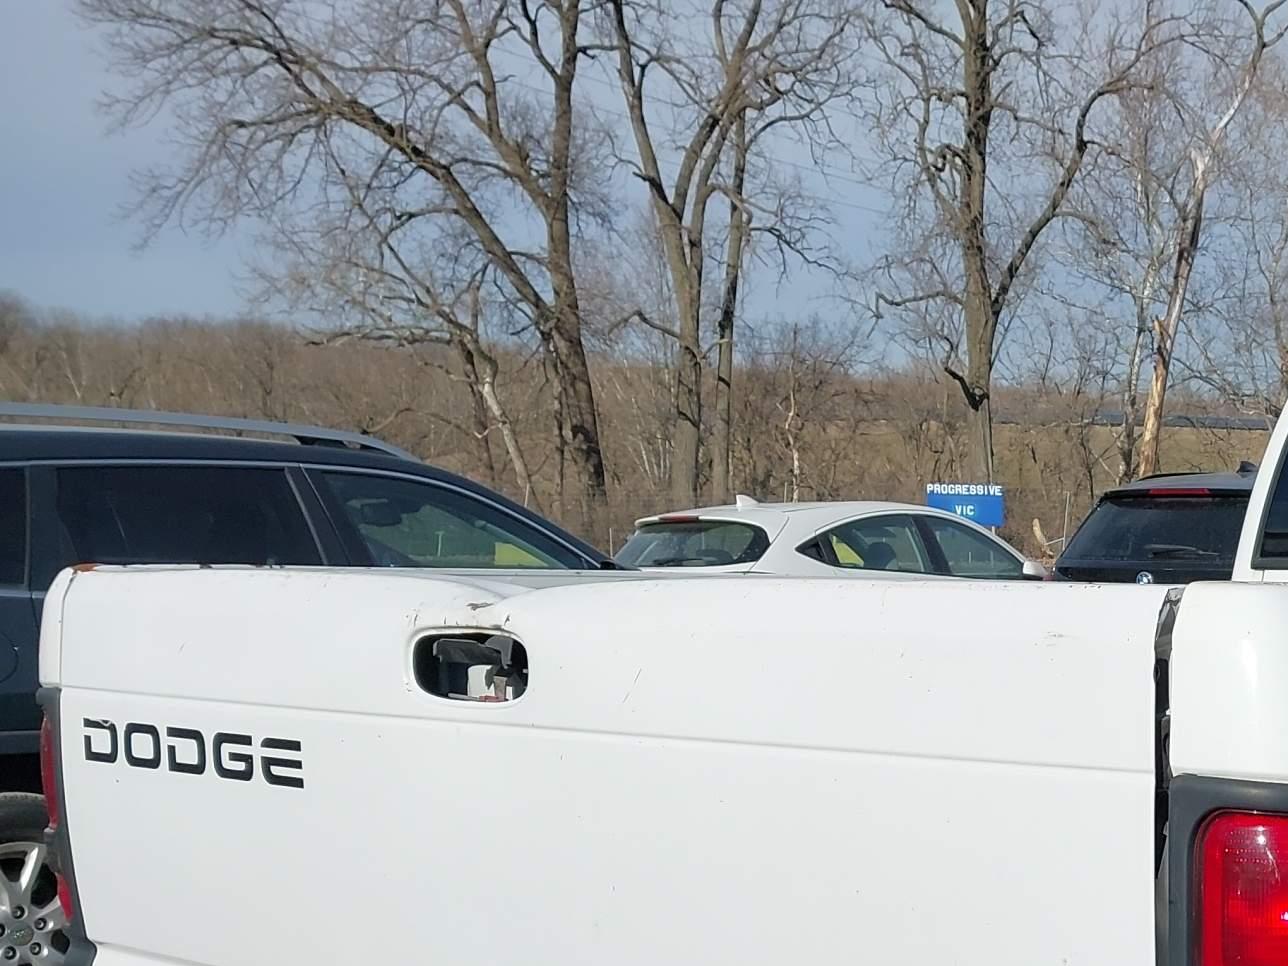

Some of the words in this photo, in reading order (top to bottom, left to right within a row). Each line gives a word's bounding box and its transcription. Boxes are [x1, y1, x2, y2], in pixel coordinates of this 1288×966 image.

[926, 483, 1003, 496] PROGRESSIVE
[955, 504, 976, 516] VIC
[83, 717, 304, 789] DODGE
